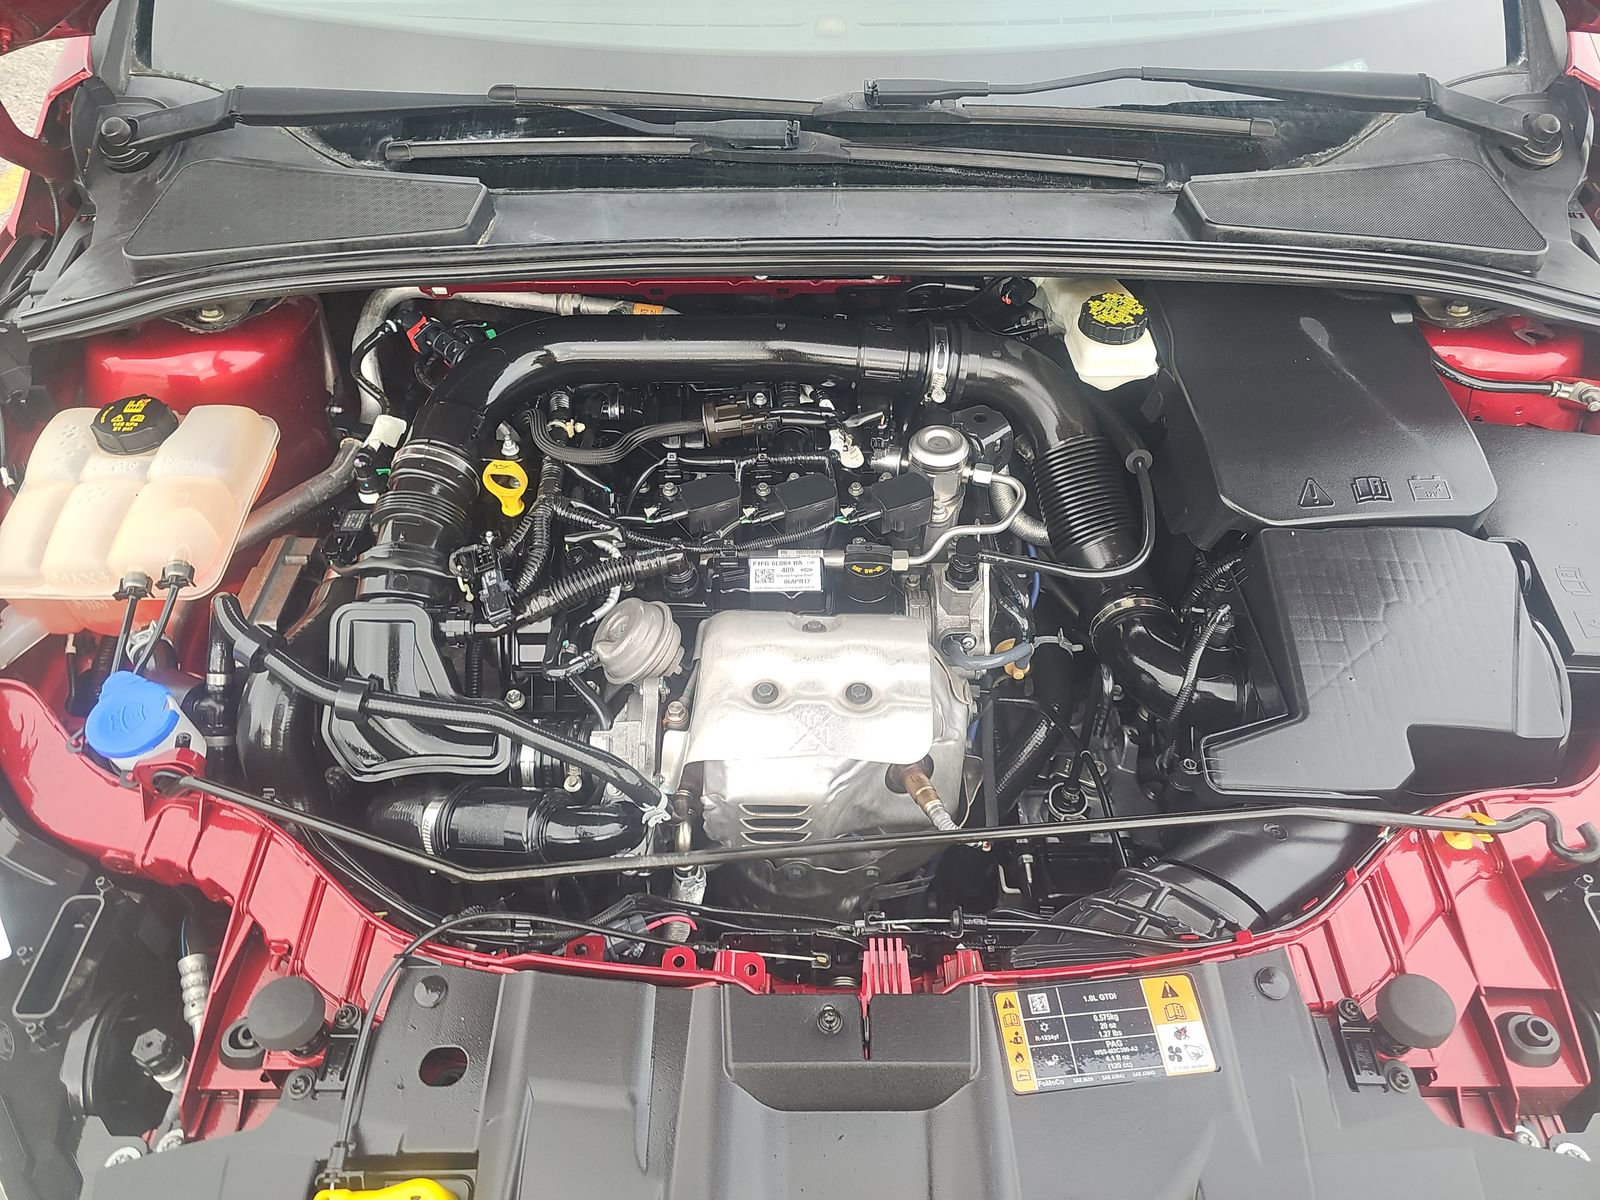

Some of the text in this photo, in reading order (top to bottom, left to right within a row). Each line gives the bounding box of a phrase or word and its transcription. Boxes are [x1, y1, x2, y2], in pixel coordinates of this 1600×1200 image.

[1083, 992, 1118, 1003] 1.0L GTDI
[1093, 1013, 1120, 1022] 0.575kg
[1098, 1030, 1111, 1038] 1.27
[1105, 1039, 1124, 1048] PAG
[1122, 1061, 1133, 1069] cc)
[1038, 1079, 1065, 1088] FoMoCo
